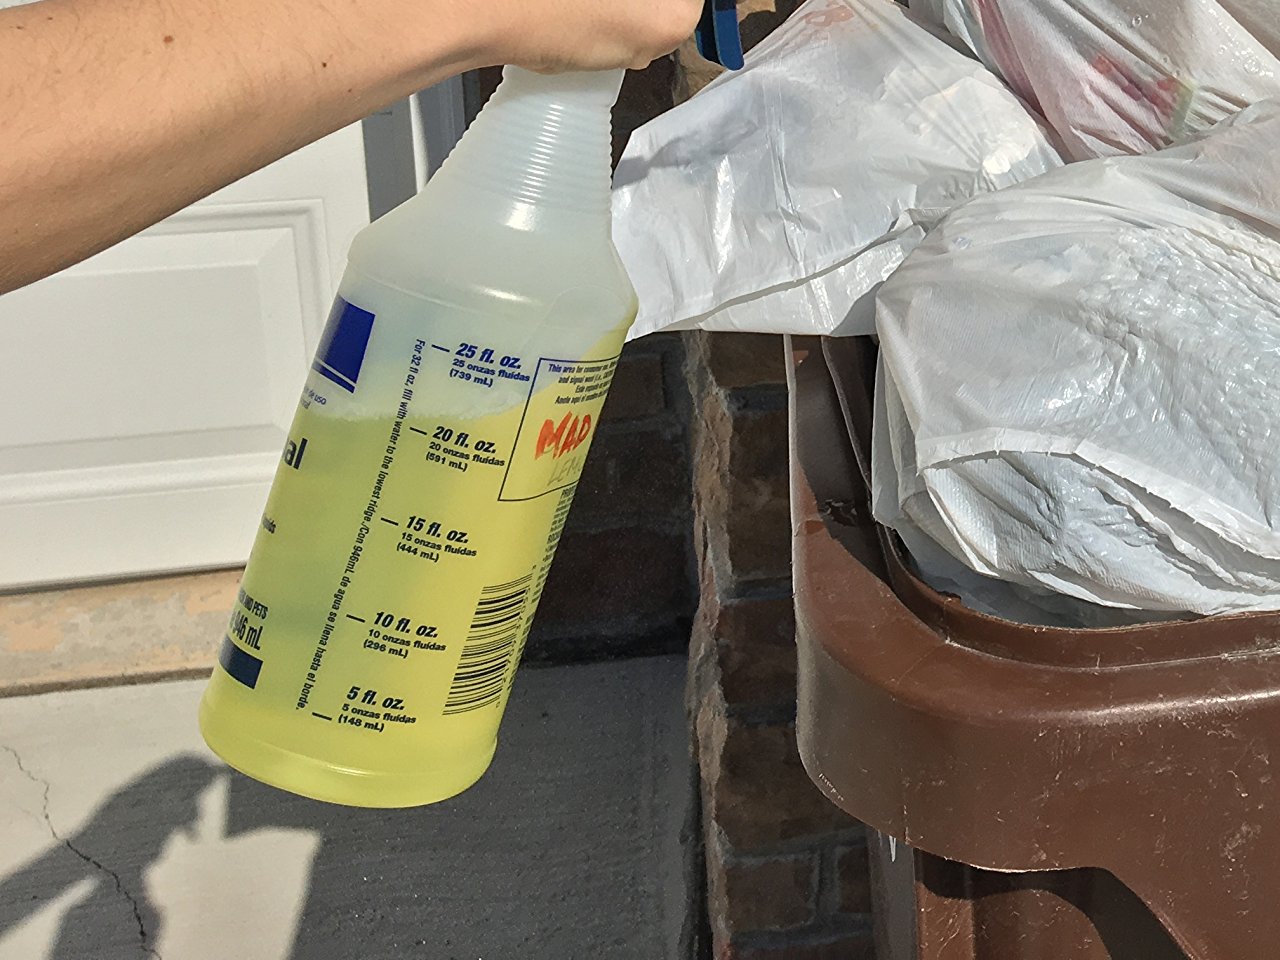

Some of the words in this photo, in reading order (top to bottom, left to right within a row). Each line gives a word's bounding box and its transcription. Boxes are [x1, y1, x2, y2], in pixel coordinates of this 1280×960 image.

[414, 339, 425, 354] For
[455, 343, 478, 359] 25
[478, 348, 495, 364] fl.
[500, 356, 522, 369] oz.
[411, 354, 422, 366] 32
[452, 358, 465, 368] 25
[467, 363, 495, 376] onzas
[449, 368, 472, 380] (739
[473, 376, 493, 388] mL)
[402, 390, 413, 401] fill
[397, 401, 408, 420] with
[390, 421, 402, 445] water
[432, 426, 453, 442] 20
[454, 432, 469, 448] fl.
[474, 440, 496, 454] oz.
[282, 437, 309, 470] al
[386, 445, 396, 455] to
[429, 442, 441, 451] 20
[443, 447, 470, 460] onzas
[381, 455, 393, 470] the
[425, 452, 446, 465] (591
[448, 460, 468, 472] mL)
[371, 470, 388, 499] lowest
[406, 515, 426, 532] 15
[426, 522, 442, 538] fl.
[446, 530, 469, 544] oz.
[401, 532, 413, 542] 15
[414, 537, 442, 551] onzas
[396, 542, 418, 556] (444
[420, 551, 439, 563] mL)
[340, 574, 351, 588] de
[332, 588, 346, 611] agua
[252, 600, 268, 620] PETS
[327, 612, 337, 623] se
[318, 623, 335, 646] llena
[374, 611, 394, 628] 10
[395, 617, 411, 634] fl.
[416, 625, 438, 638] oz.
[245, 626, 264, 651] mL
[369, 629, 380, 639] 10
[382, 634, 411, 647] onzas
[363, 639, 386, 652] (296
[388, 647, 409, 659] mL)
[309, 647, 326, 672] hasta
[306, 671, 316, 683] el
[296, 683, 315, 710] borde.
[346, 686, 361, 700] 5
[361, 690, 377, 706] fl.
[382, 697, 404, 710] oz.
[342, 703, 350, 711] 5
[351, 706, 380, 719] onzas
[338, 713, 363, 727] (148
[364, 721, 385, 732] mL)
